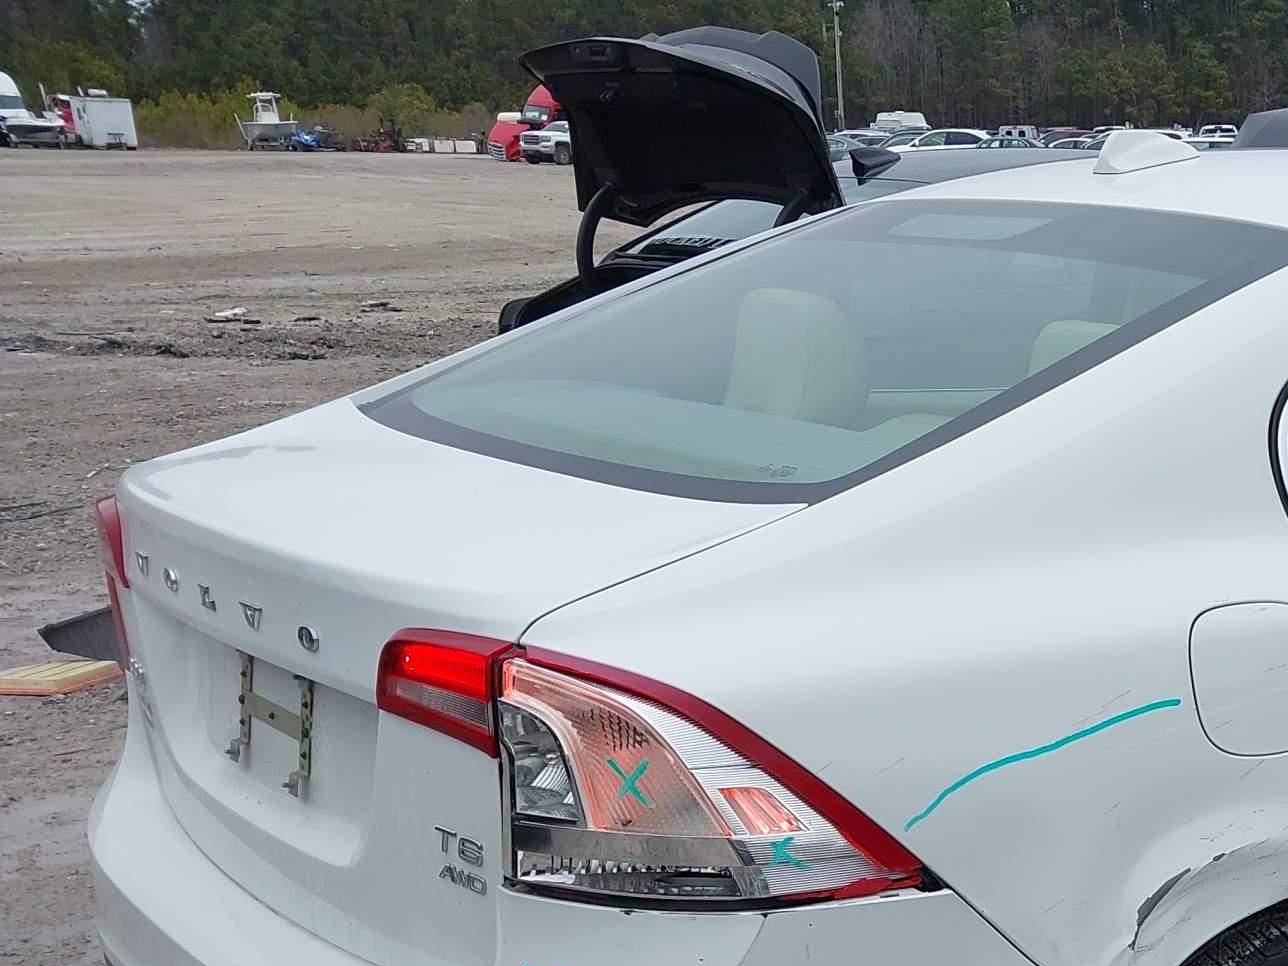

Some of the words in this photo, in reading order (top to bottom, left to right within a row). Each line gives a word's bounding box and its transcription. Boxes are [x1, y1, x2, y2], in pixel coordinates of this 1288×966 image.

[135, 551, 320, 653] VOLVO
[433, 824, 484, 867] T6
[438, 863, 488, 896] AWD
